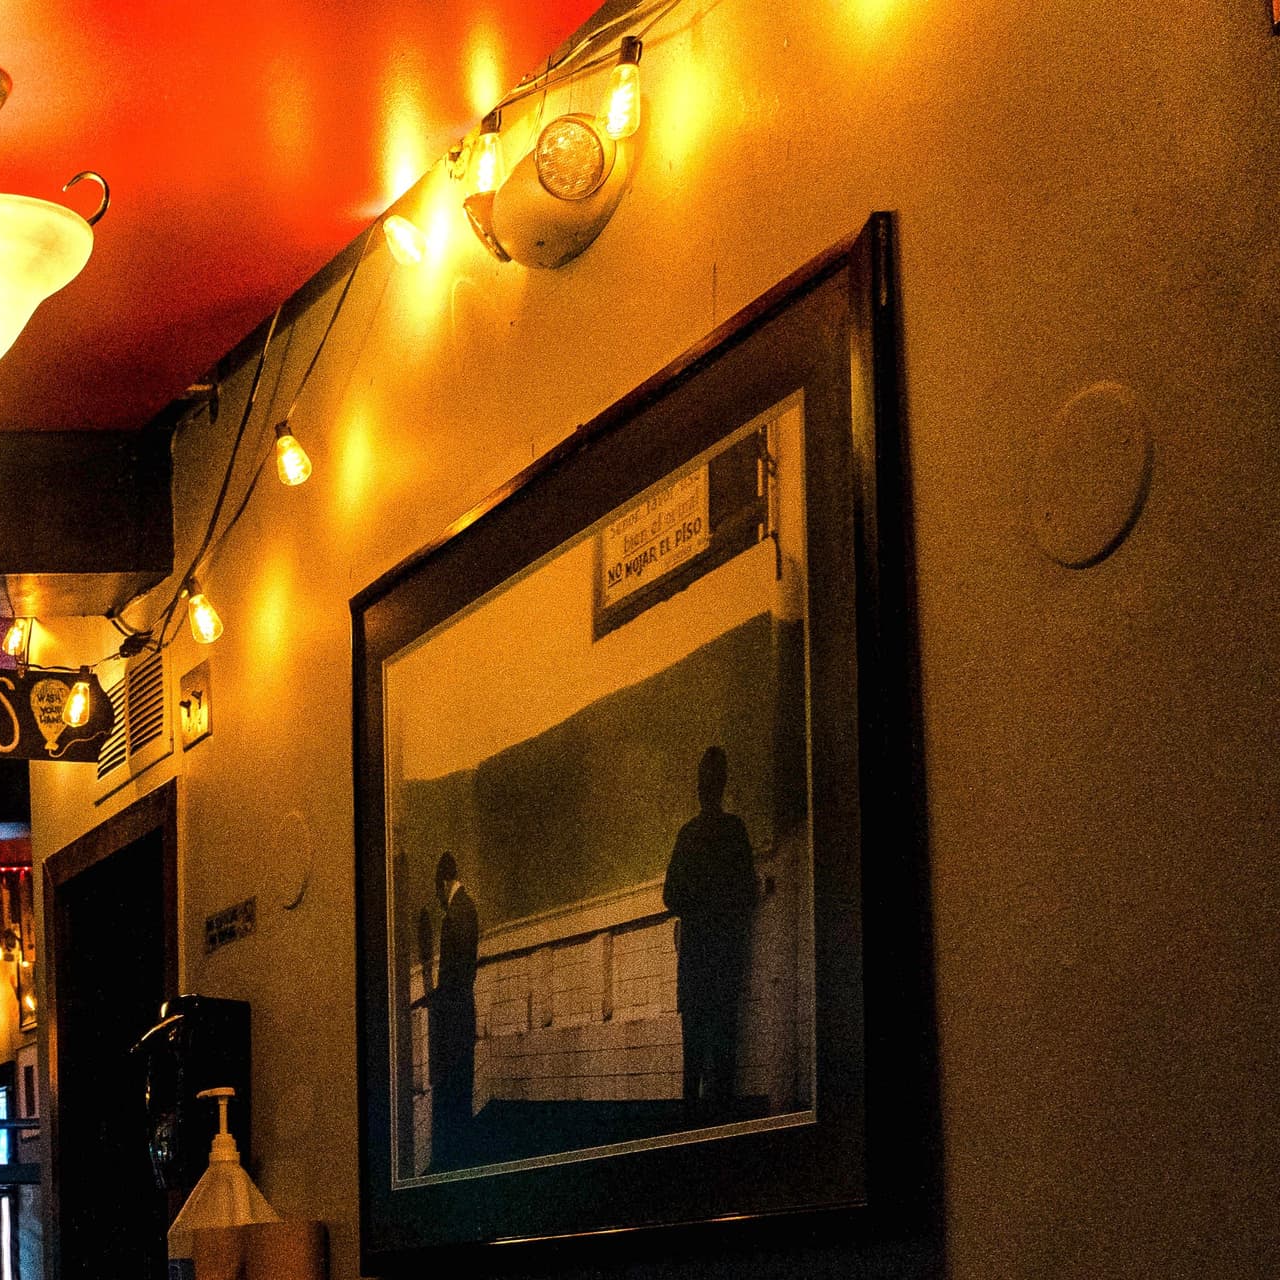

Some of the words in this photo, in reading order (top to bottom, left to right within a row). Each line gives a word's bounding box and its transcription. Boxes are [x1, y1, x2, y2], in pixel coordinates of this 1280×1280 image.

[607, 562, 623, 583] NO
[659, 536, 670, 556] EL
[675, 517, 702, 546] PISO
